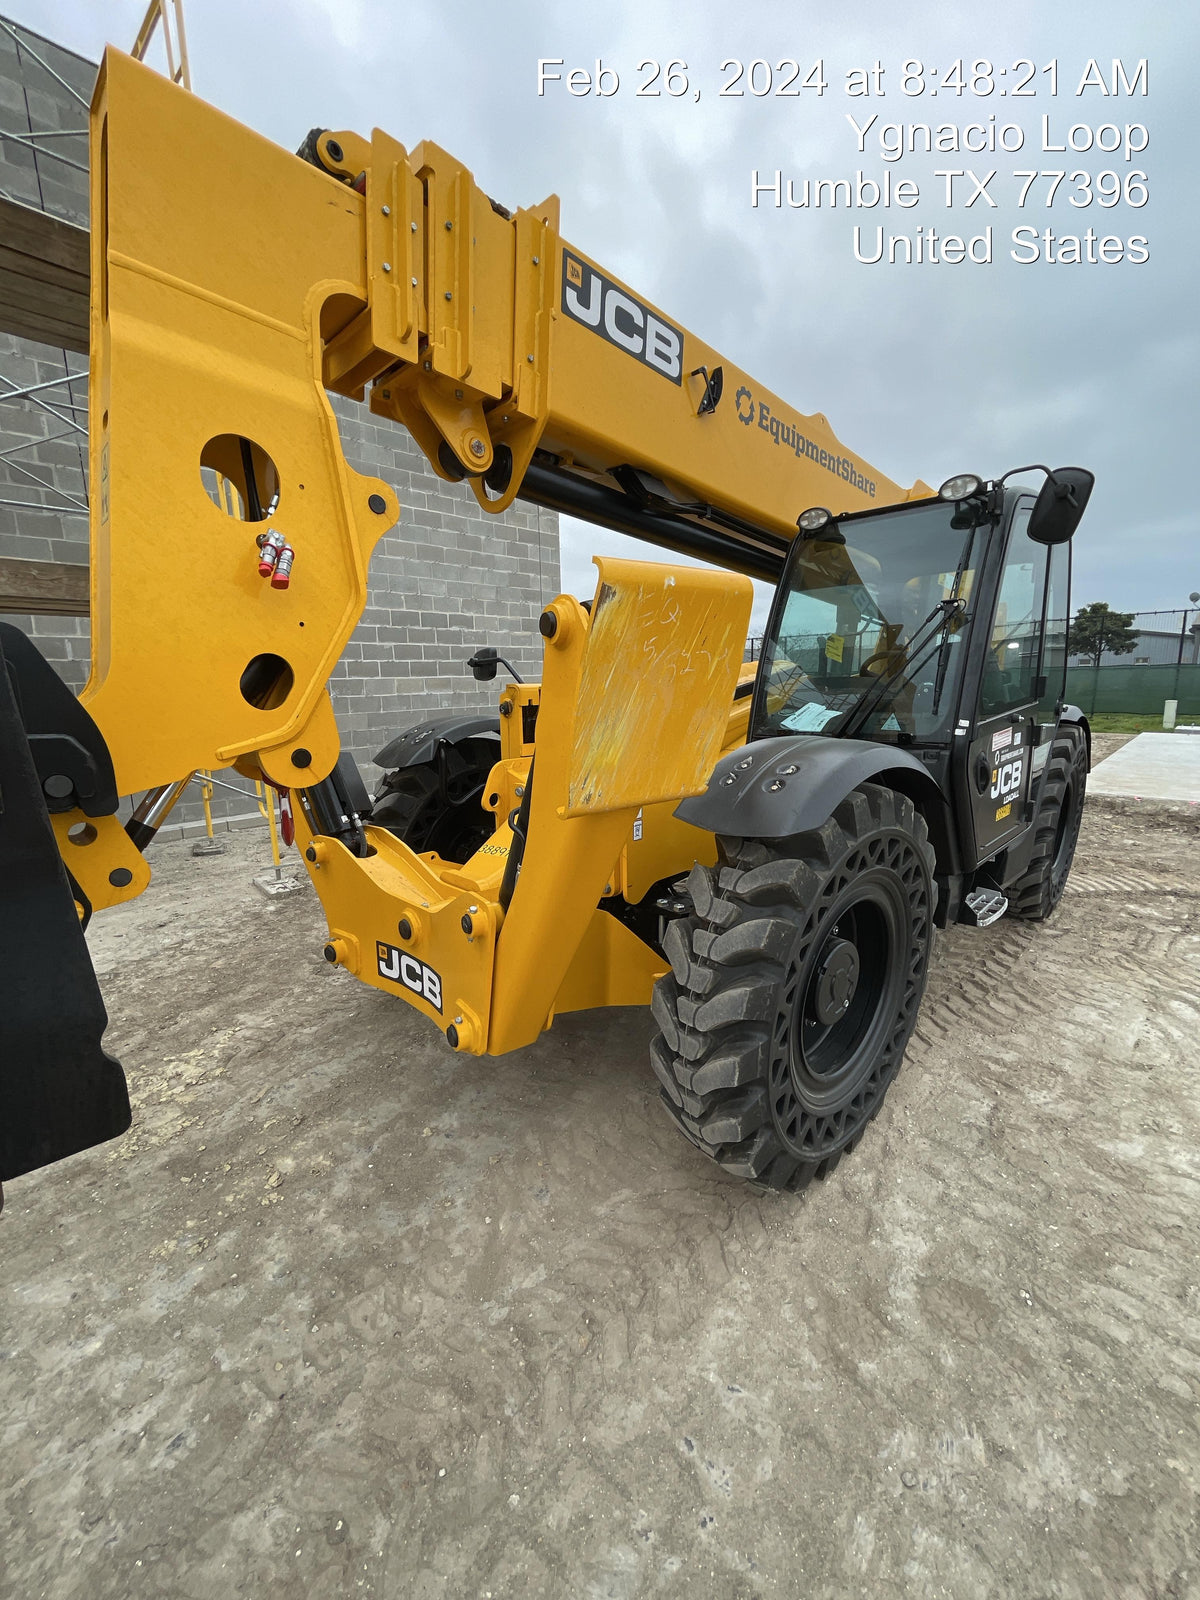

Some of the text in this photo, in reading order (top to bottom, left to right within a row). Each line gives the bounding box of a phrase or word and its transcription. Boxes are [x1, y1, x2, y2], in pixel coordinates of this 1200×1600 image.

[565, 273, 681, 378] JCB
[757, 401, 876, 498] EquipmentShare
[990, 760, 1022, 799] JCB
[379, 949, 442, 1009] JCB
